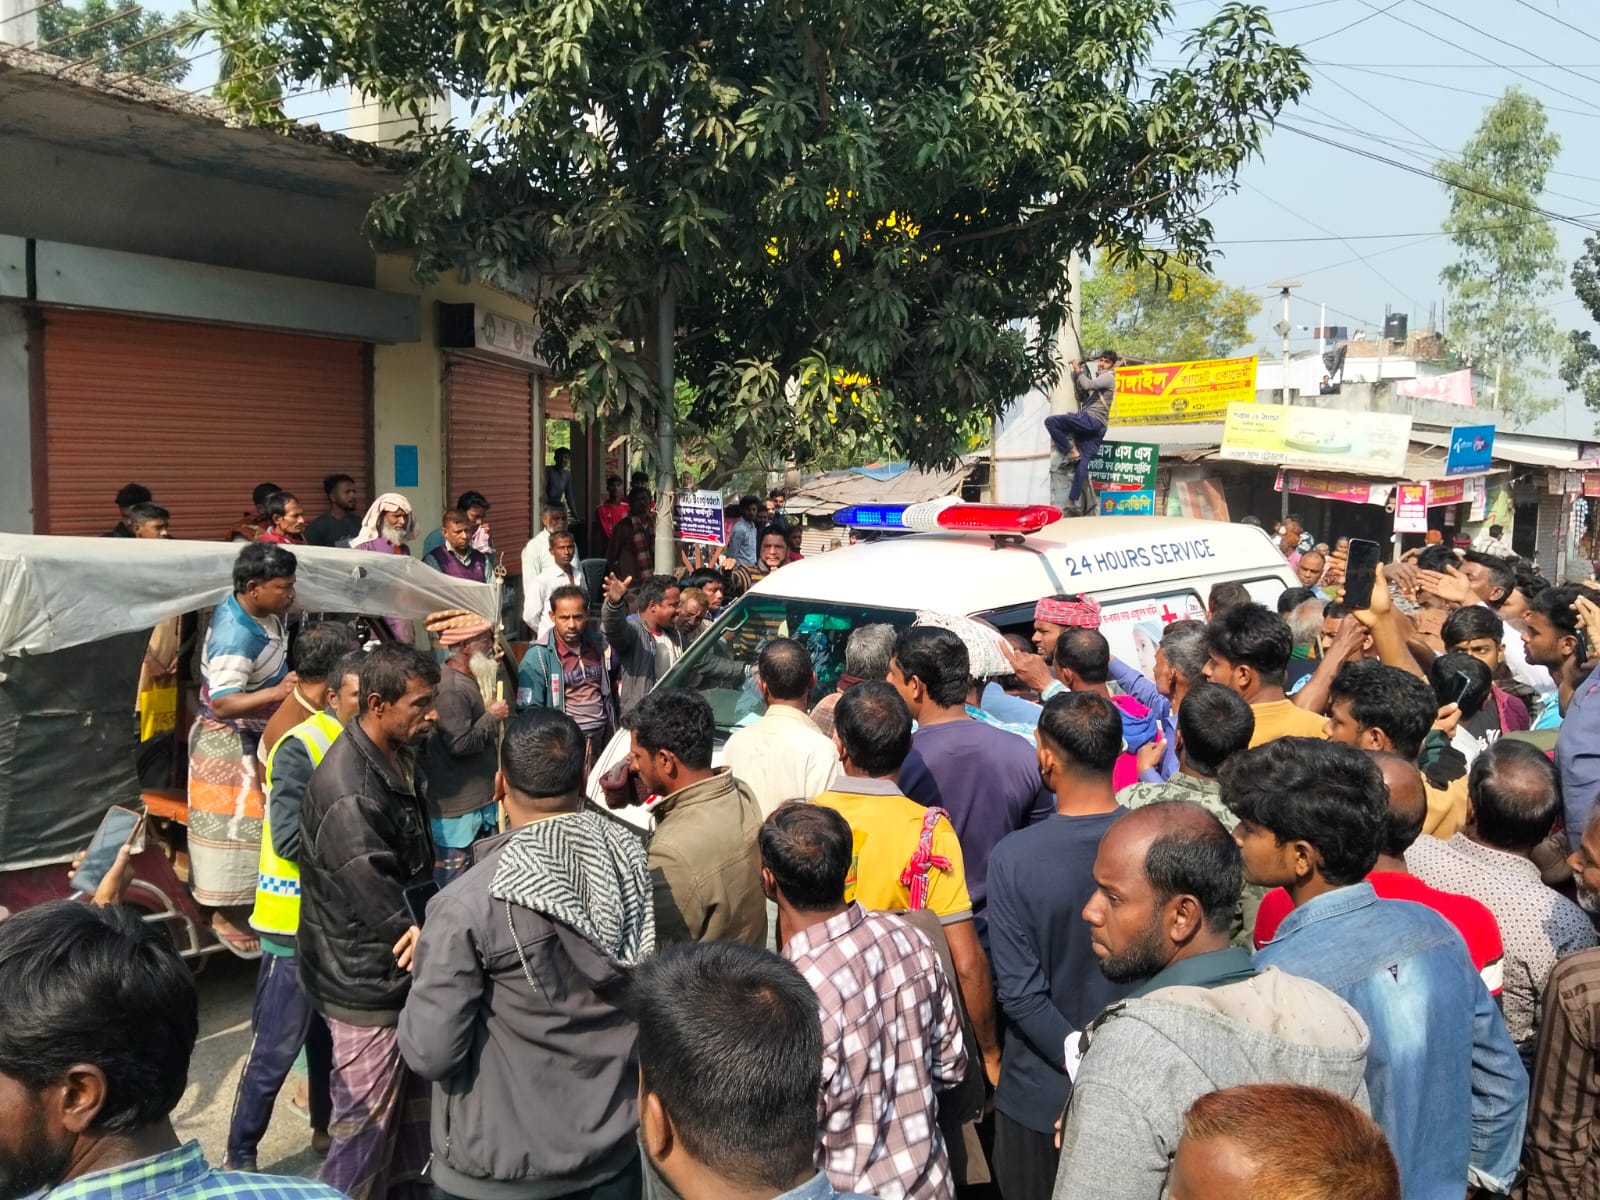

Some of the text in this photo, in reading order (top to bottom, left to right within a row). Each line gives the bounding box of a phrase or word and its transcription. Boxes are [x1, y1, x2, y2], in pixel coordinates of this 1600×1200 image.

[1115, 445, 1133, 459] এস
[1134, 446, 1153, 461] এস
[693, 494, 720, 506] Bangladesh
[1117, 494, 1151, 512] এনডিপি
[1065, 538, 1215, 577] 24 HOURS SERVICE
